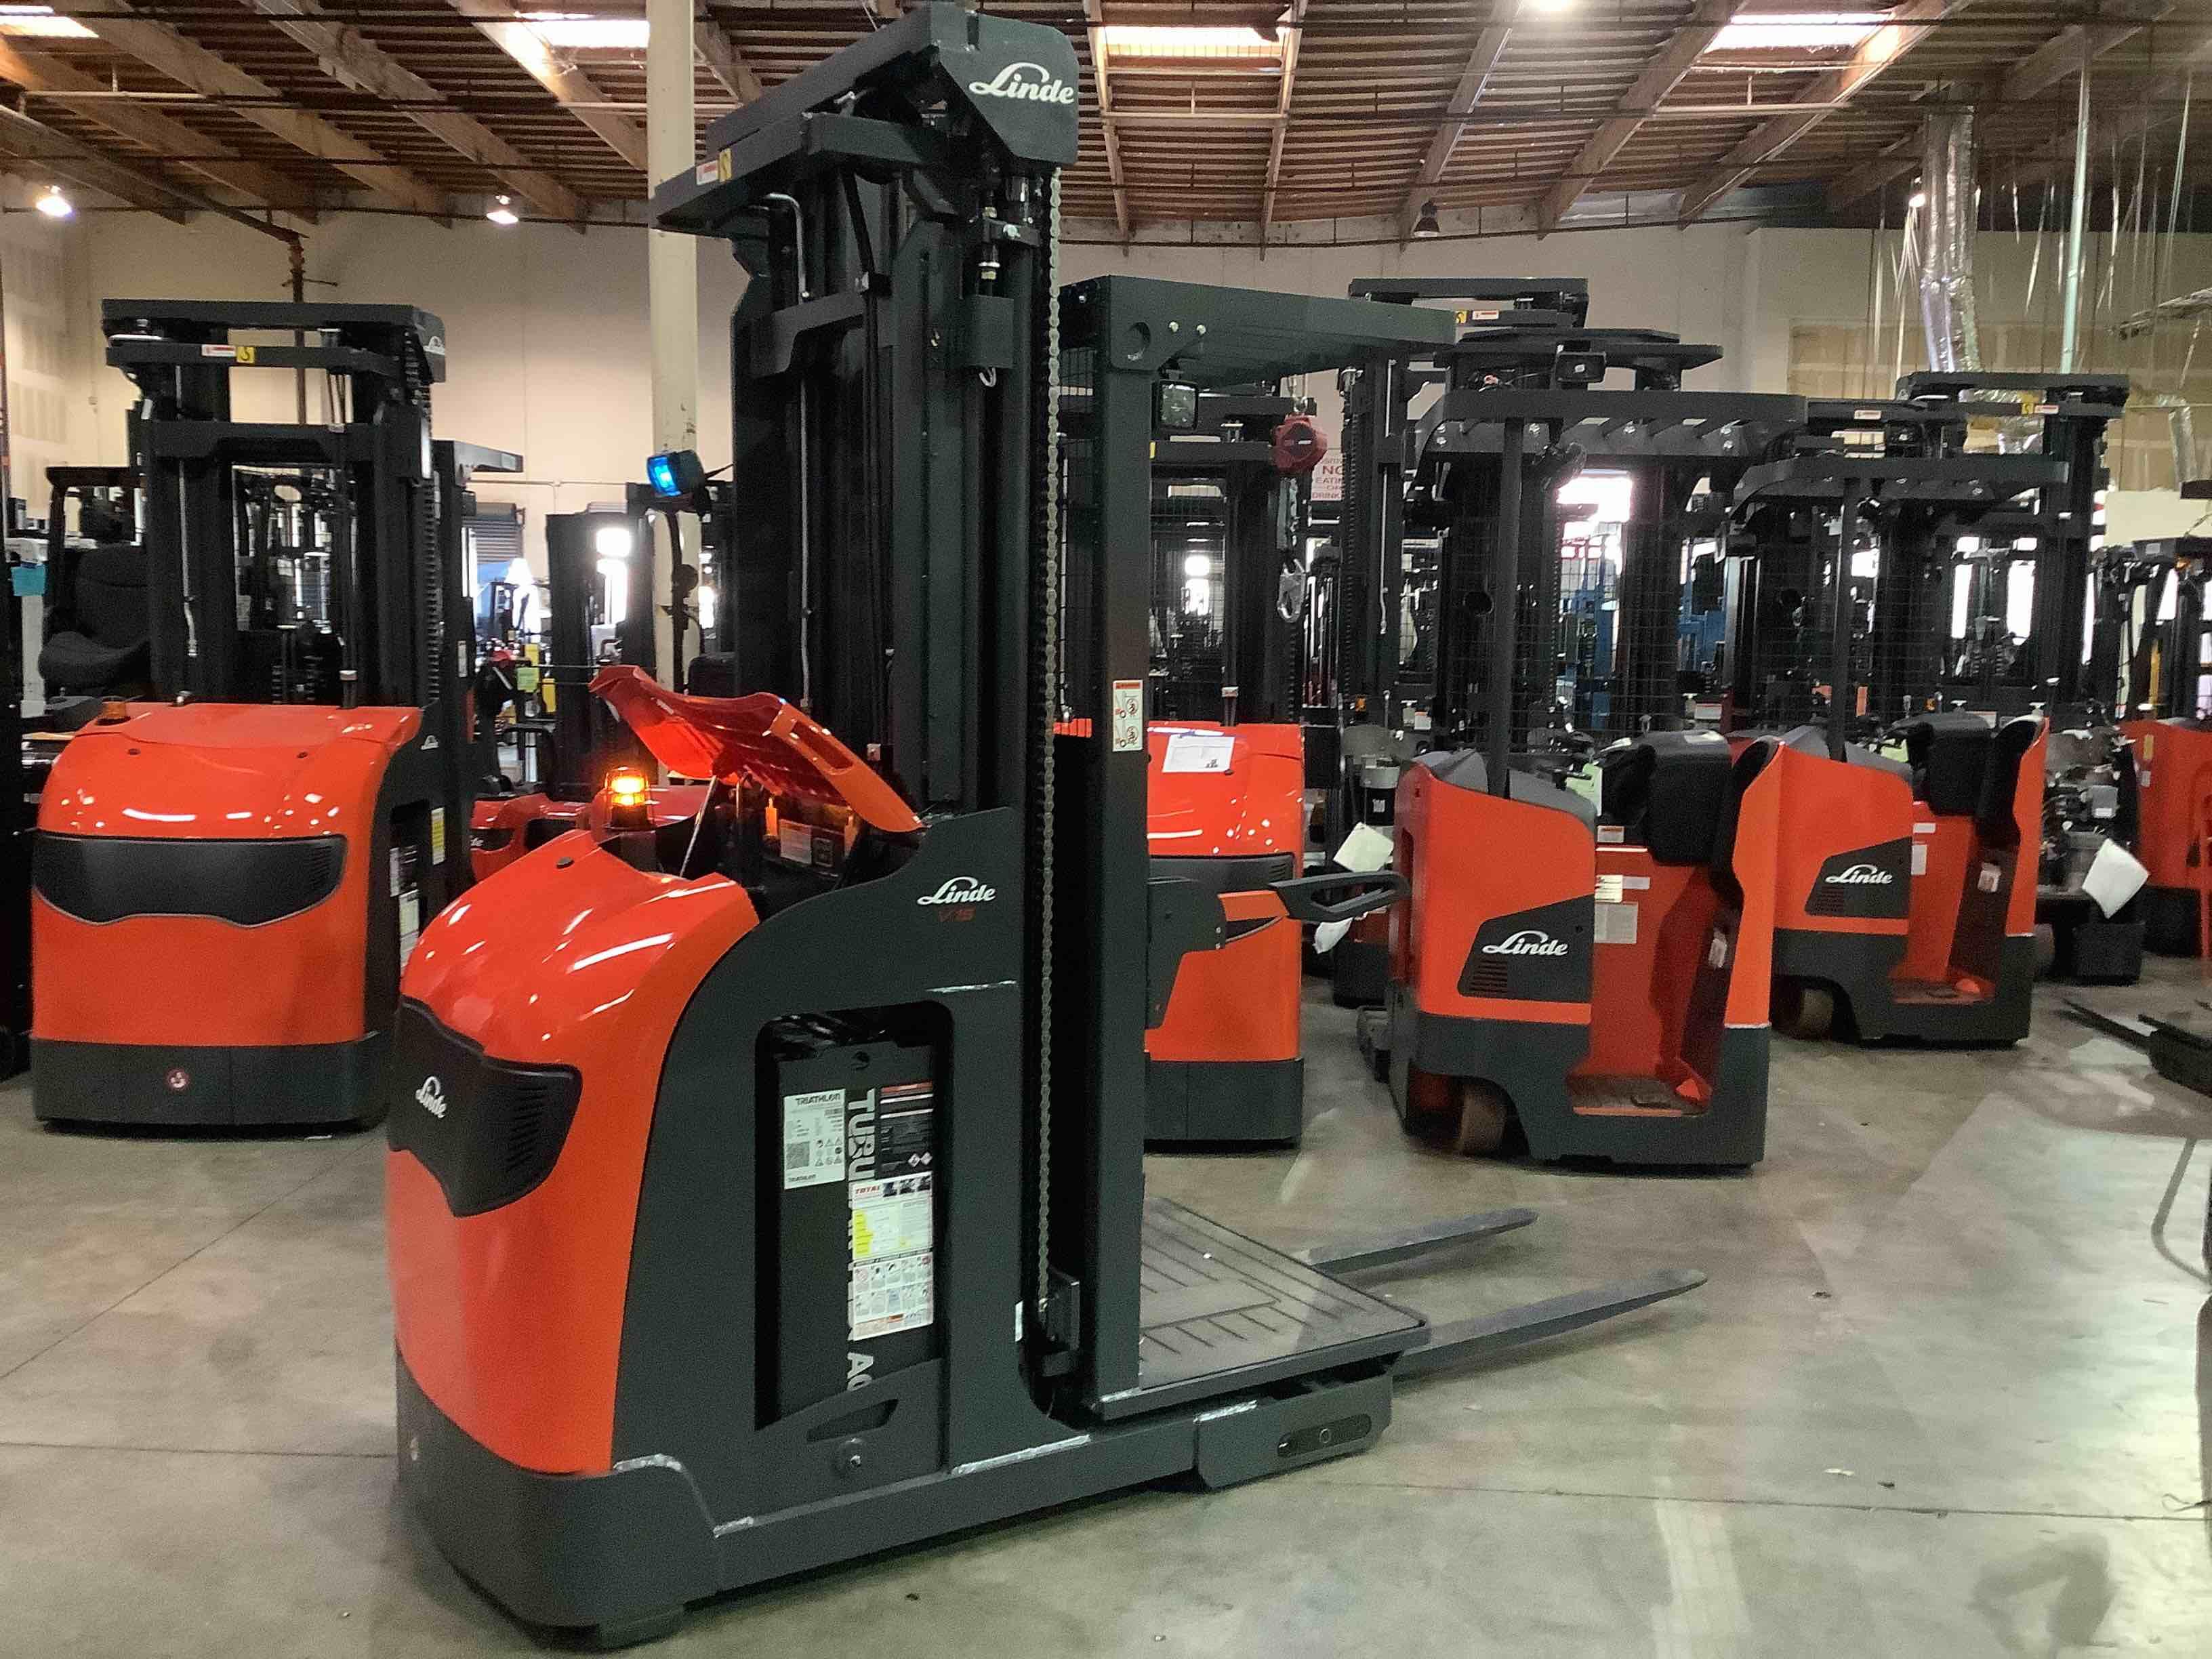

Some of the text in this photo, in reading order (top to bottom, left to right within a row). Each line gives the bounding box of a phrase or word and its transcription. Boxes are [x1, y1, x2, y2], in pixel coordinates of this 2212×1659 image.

[969, 62, 1074, 104] Linde
[1826, 865, 1892, 884] Linde
[918, 877, 995, 905] Linde
[1482, 930, 1568, 956] Linde
[415, 1076, 446, 1118] Linde
